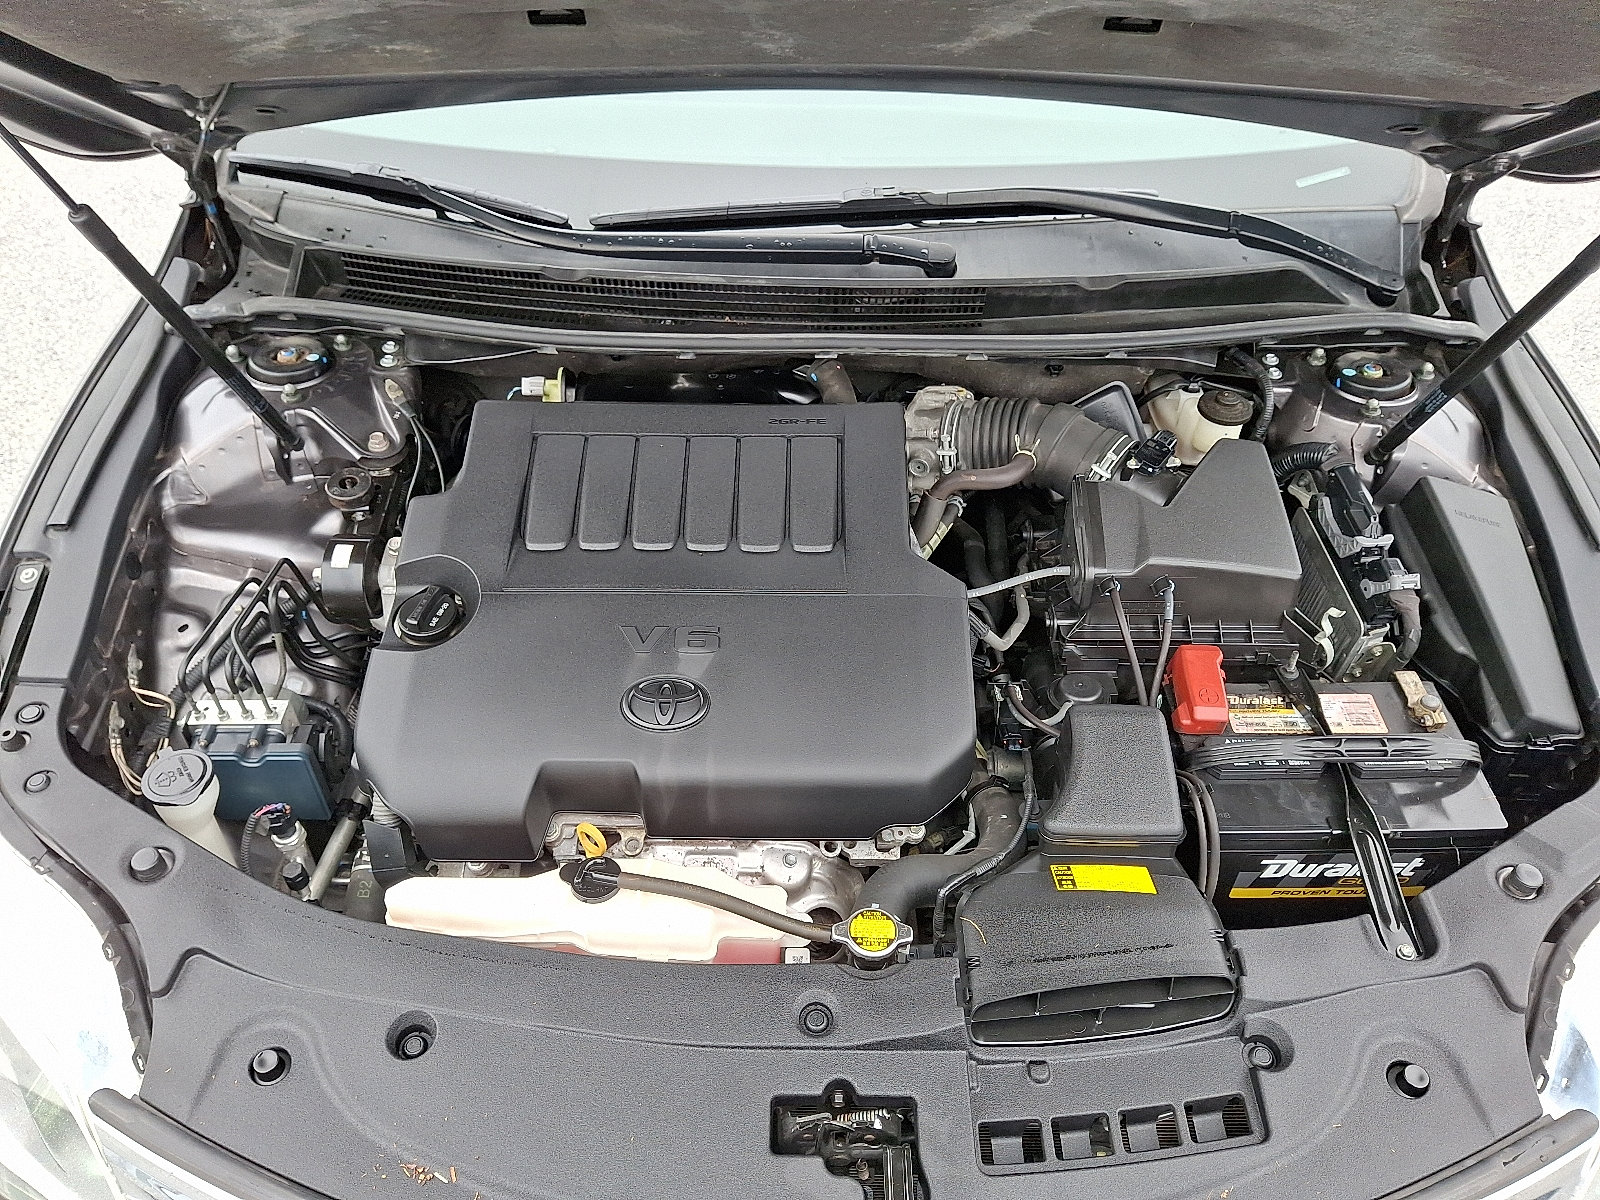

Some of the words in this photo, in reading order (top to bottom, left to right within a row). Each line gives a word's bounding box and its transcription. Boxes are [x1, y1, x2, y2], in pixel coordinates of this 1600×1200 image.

[620, 625, 721, 654] V6
[1227, 695, 1284, 705] Duralast
[1260, 858, 1424, 878] Duralst
[1270, 889, 1332, 897] PROVEN
